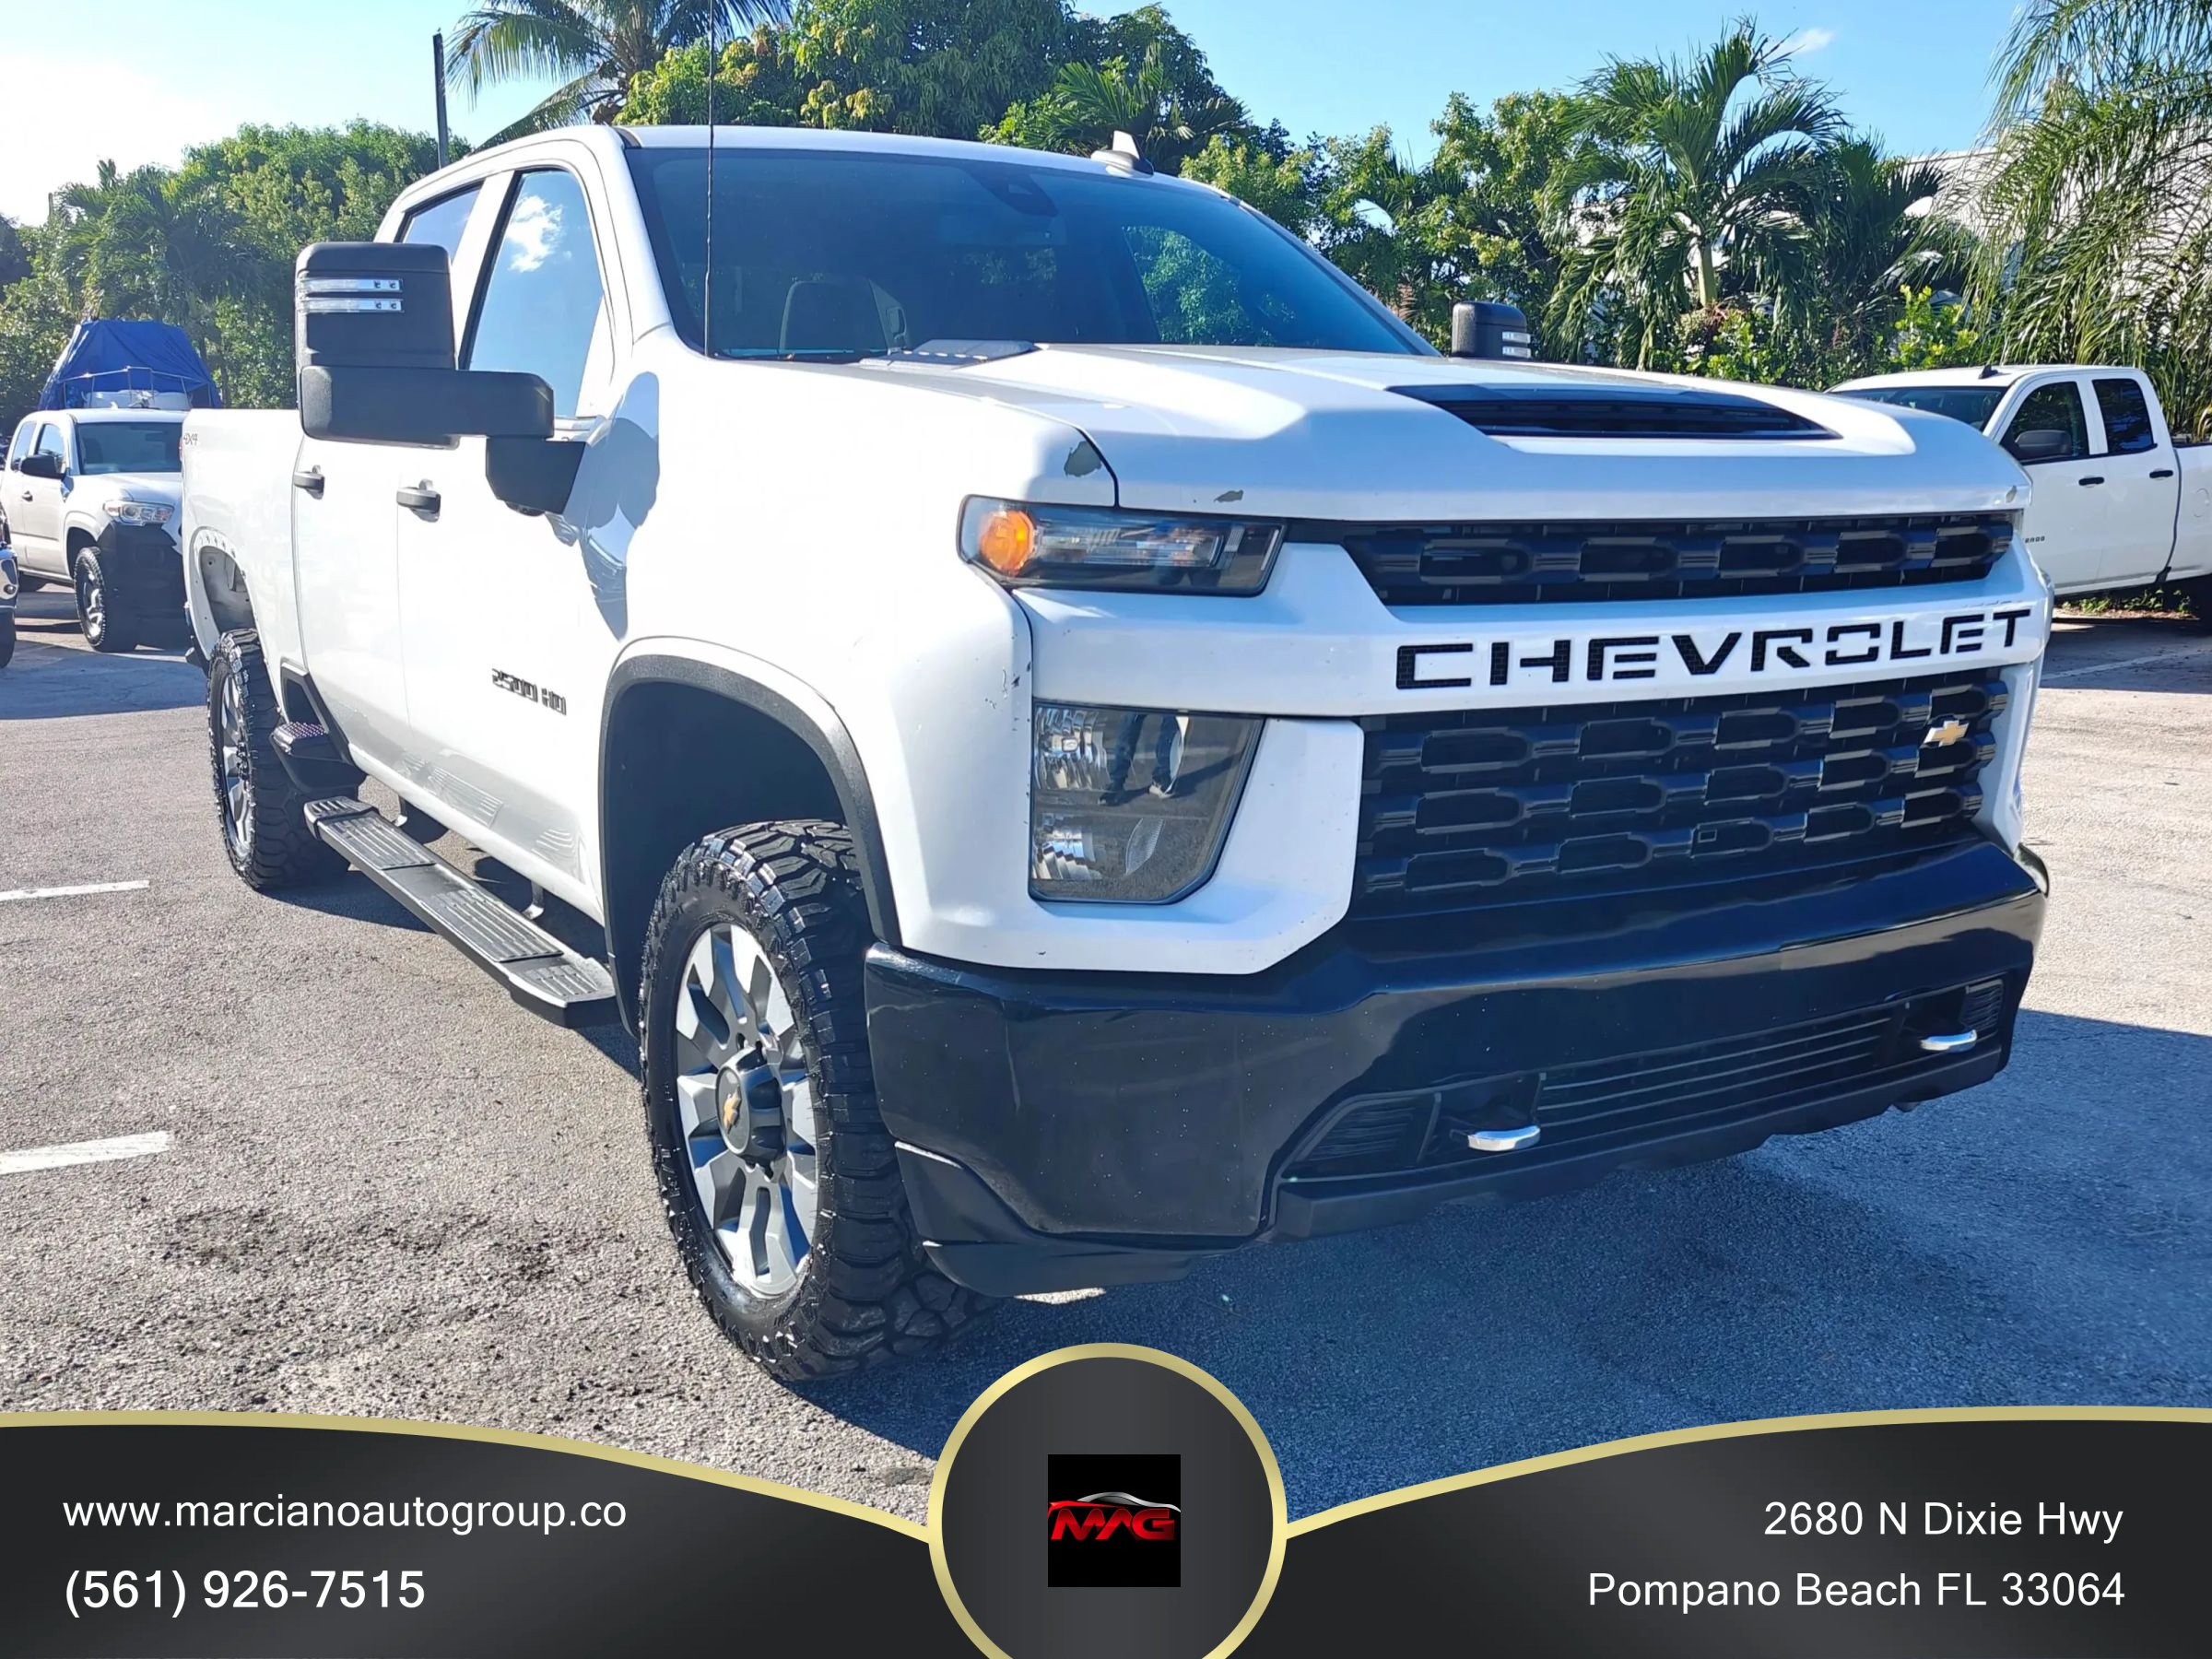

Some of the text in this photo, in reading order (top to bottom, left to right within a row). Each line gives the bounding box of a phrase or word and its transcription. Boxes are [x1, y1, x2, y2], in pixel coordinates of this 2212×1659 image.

[1395, 608, 2031, 690] CHEVROLET
[491, 667, 567, 716] 2500 HD
